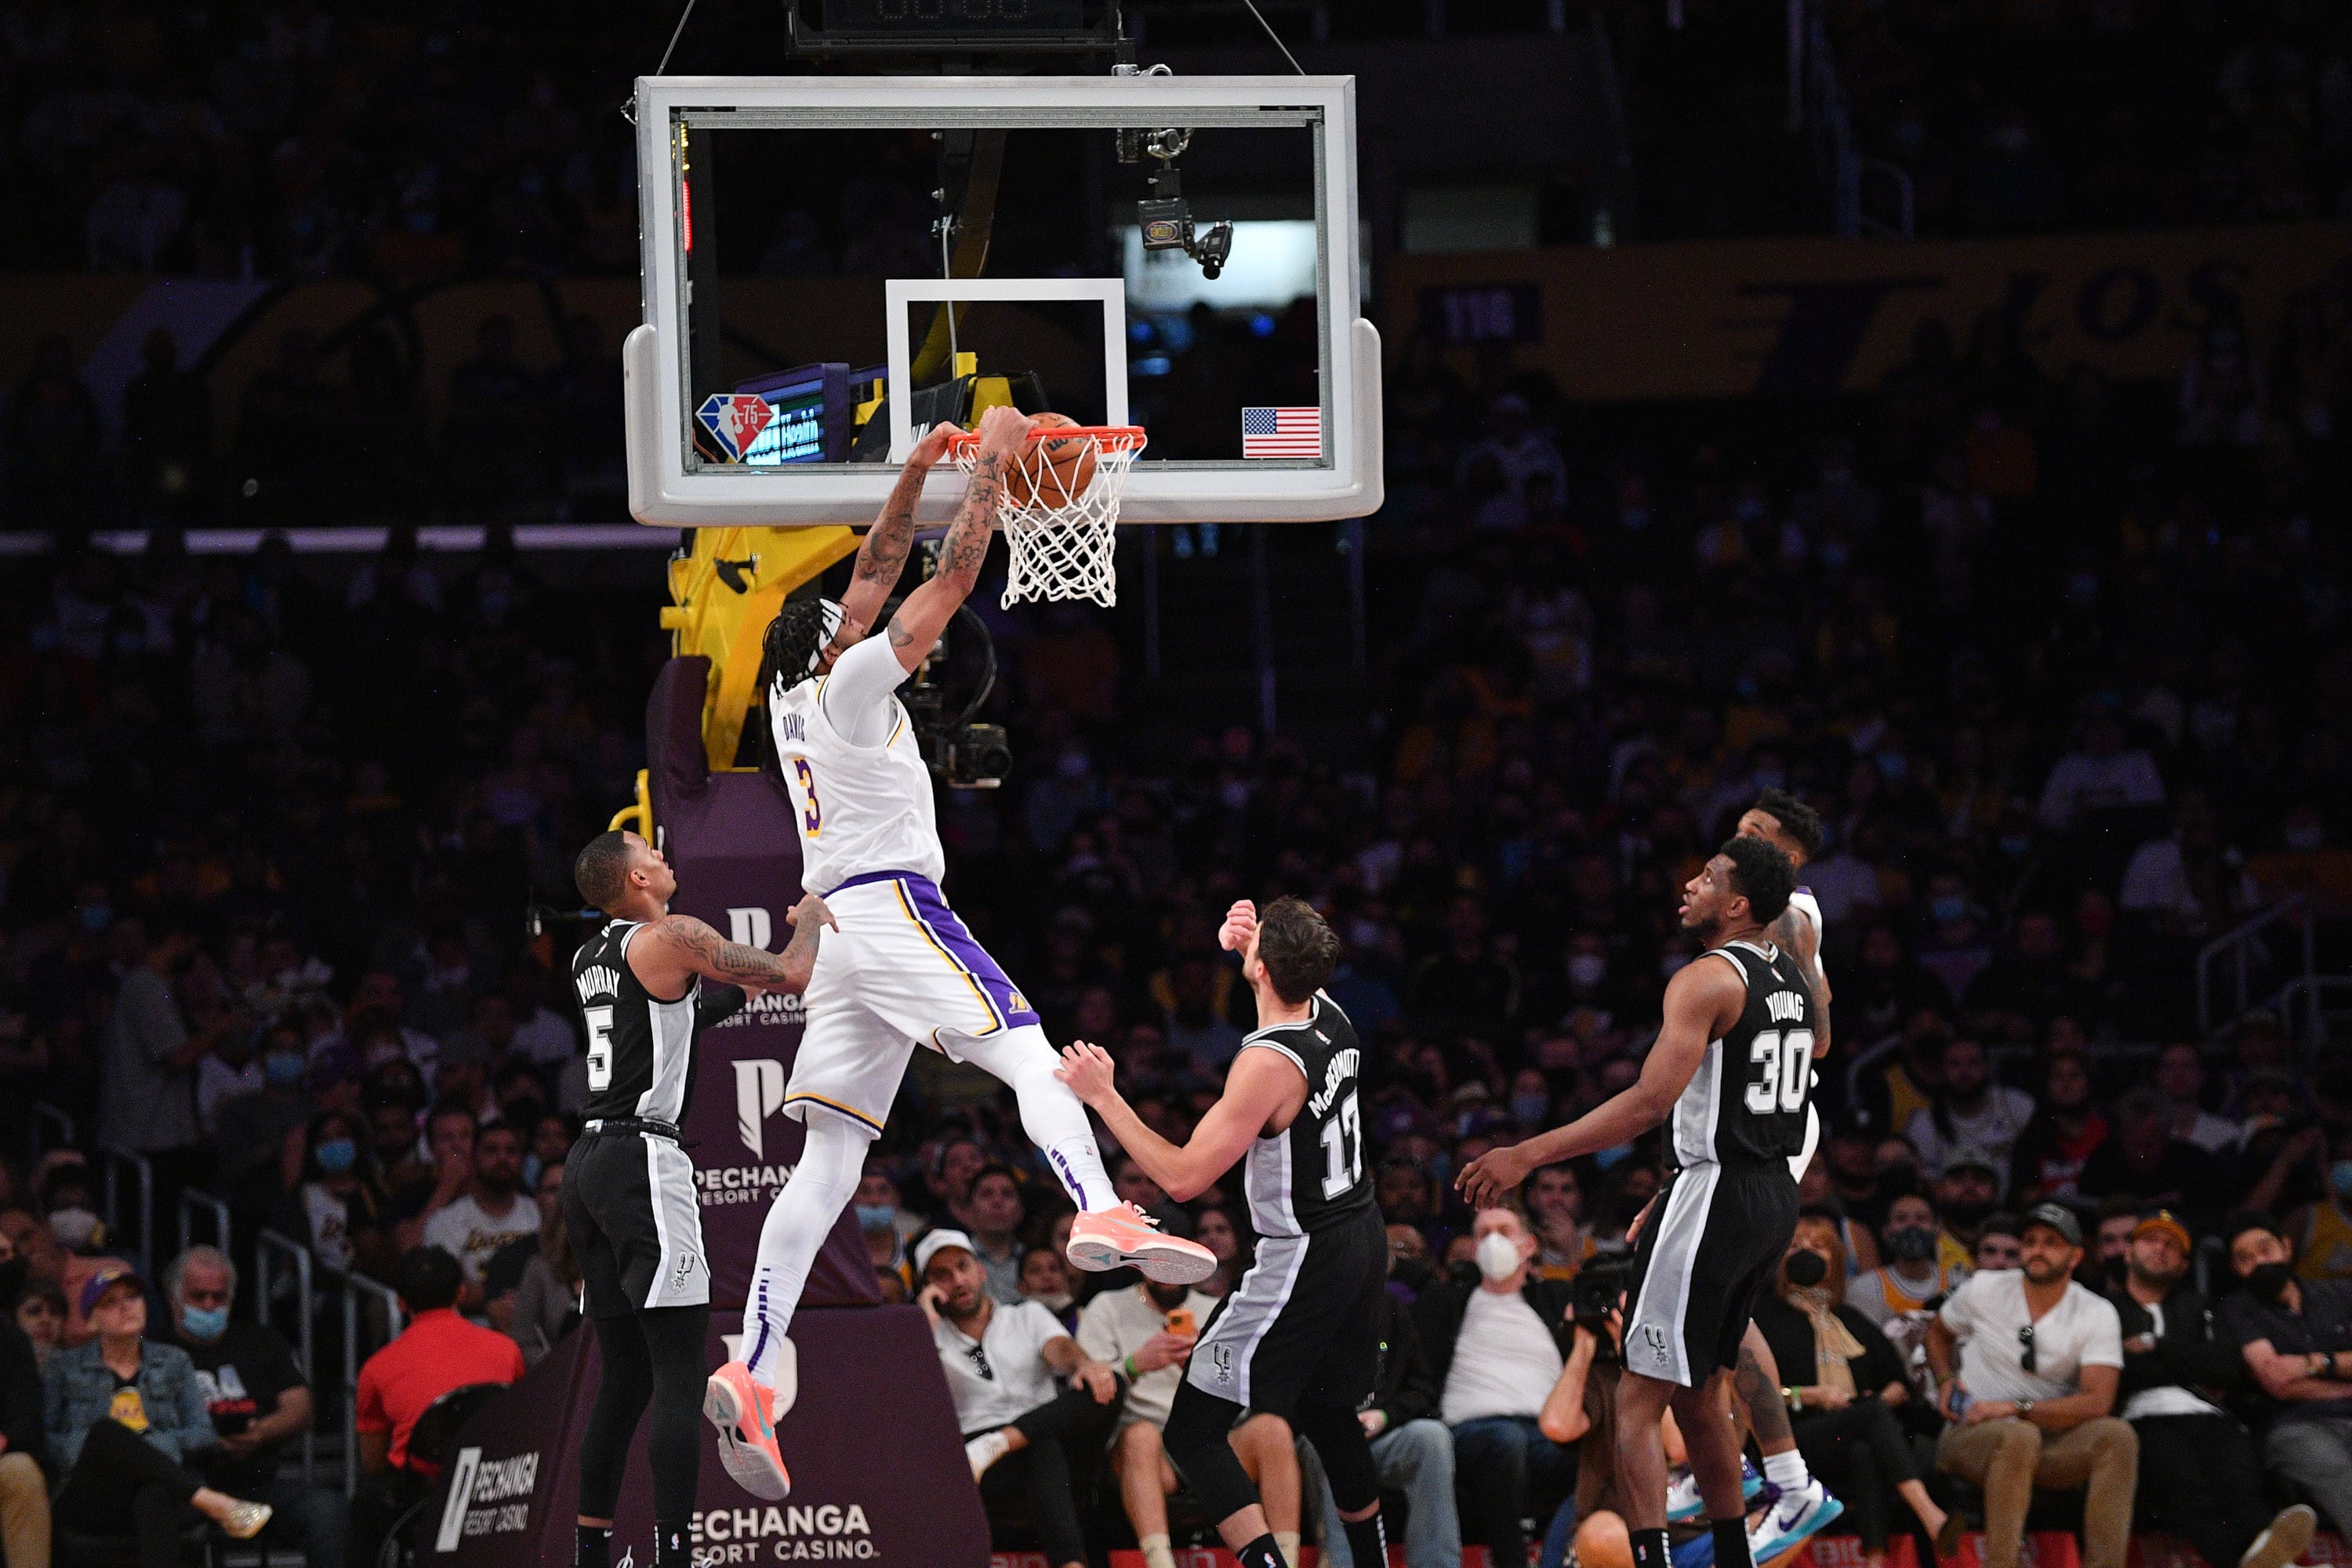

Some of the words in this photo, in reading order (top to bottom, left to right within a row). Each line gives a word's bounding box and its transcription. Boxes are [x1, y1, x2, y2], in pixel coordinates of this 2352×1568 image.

[743, 405, 758, 425] 75
[783, 713, 805, 742] DAVIS
[793, 756, 822, 837] 3
[575, 964, 620, 1004] MURRAY
[760, 1011, 806, 1026] CASIN
[1766, 990, 1804, 1023] YOUNG
[583, 1004, 613, 1091] 5
[1744, 1029, 1815, 1115] 30
[1320, 1086, 1362, 1201] 17
[697, 1188, 760, 1206] ESORT
[691, 1504, 872, 1541] ECHANGA
[691, 1541, 760, 1567] SORT
[774, 1538, 874, 1560] CASINO
